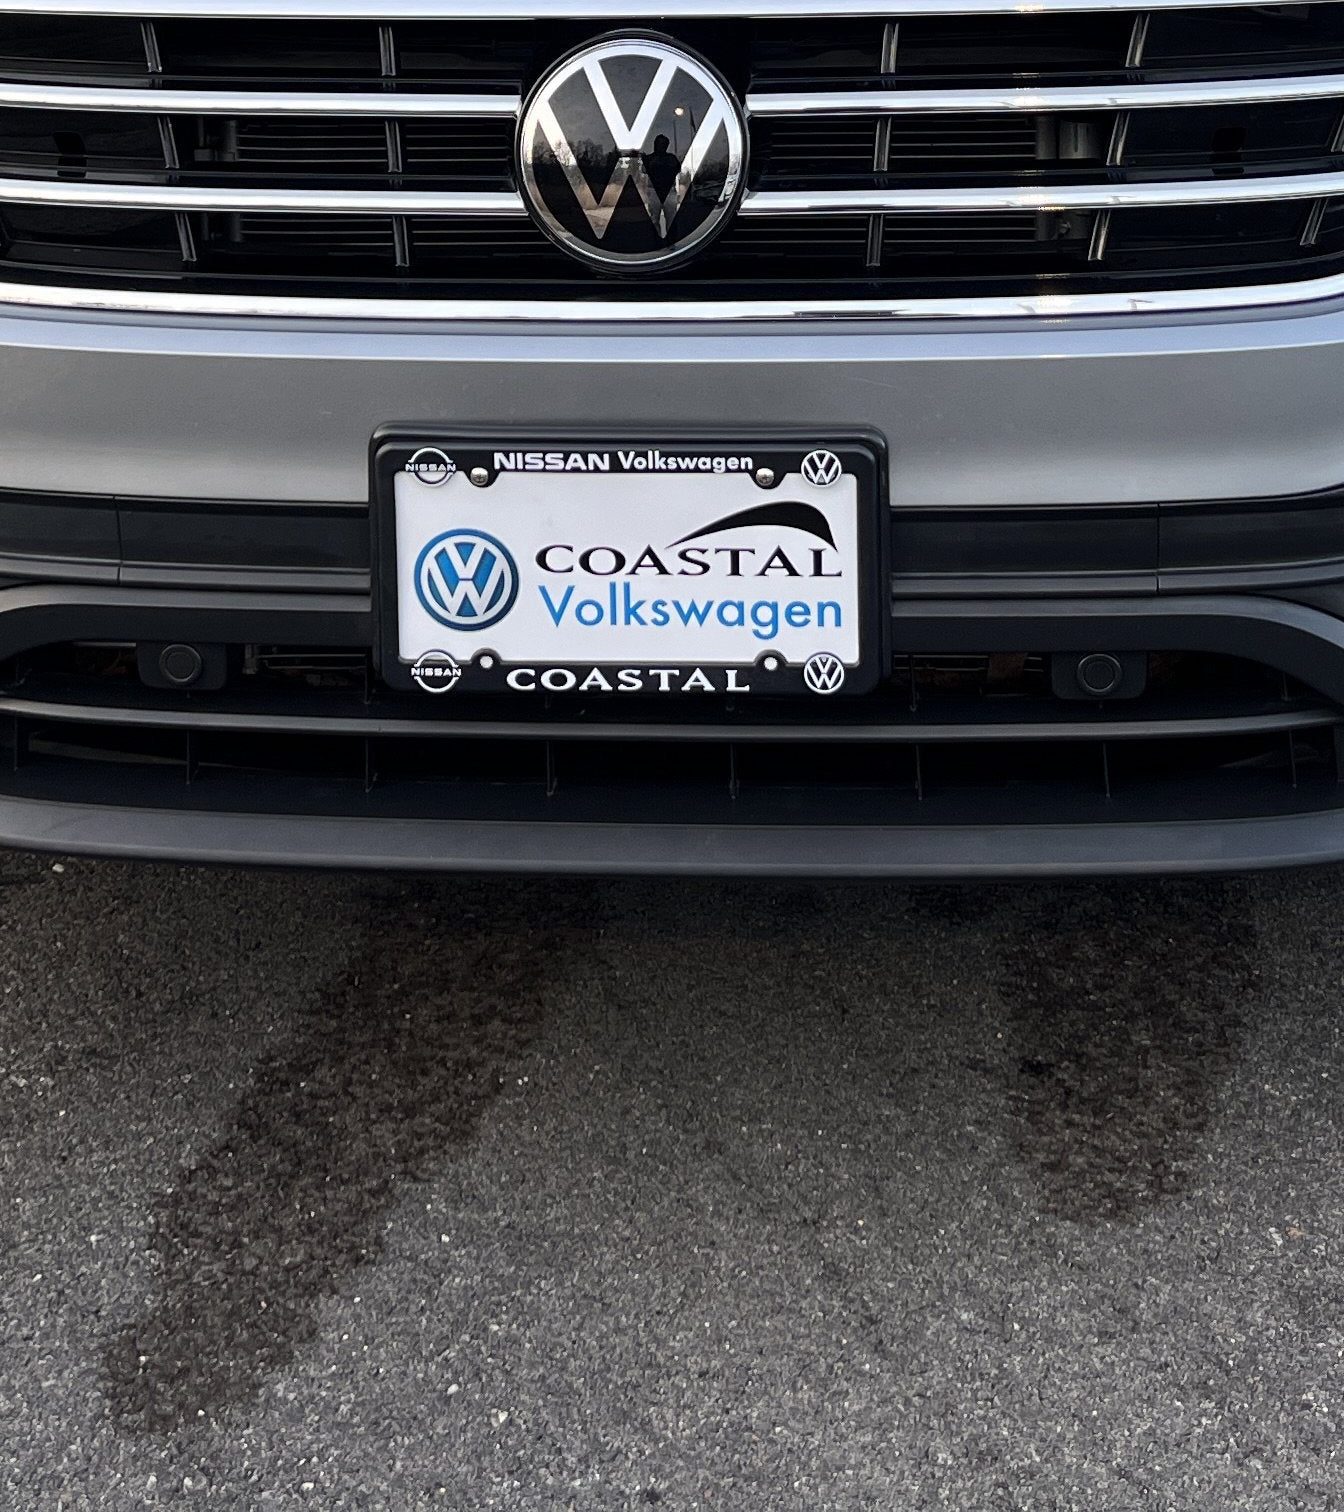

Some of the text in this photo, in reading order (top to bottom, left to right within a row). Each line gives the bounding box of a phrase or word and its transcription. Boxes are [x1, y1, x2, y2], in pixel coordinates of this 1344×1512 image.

[522, 42, 740, 260] VW
[405, 462, 456, 472] NISSAN
[493, 450, 753, 474] NISSAN Volkswagen
[535, 544, 843, 578] COASTAL
[416, 530, 518, 629] VW
[537, 581, 843, 641] Volkswagen
[410, 666, 462, 678] NISSAN
[506, 667, 750, 693] COASTAL
